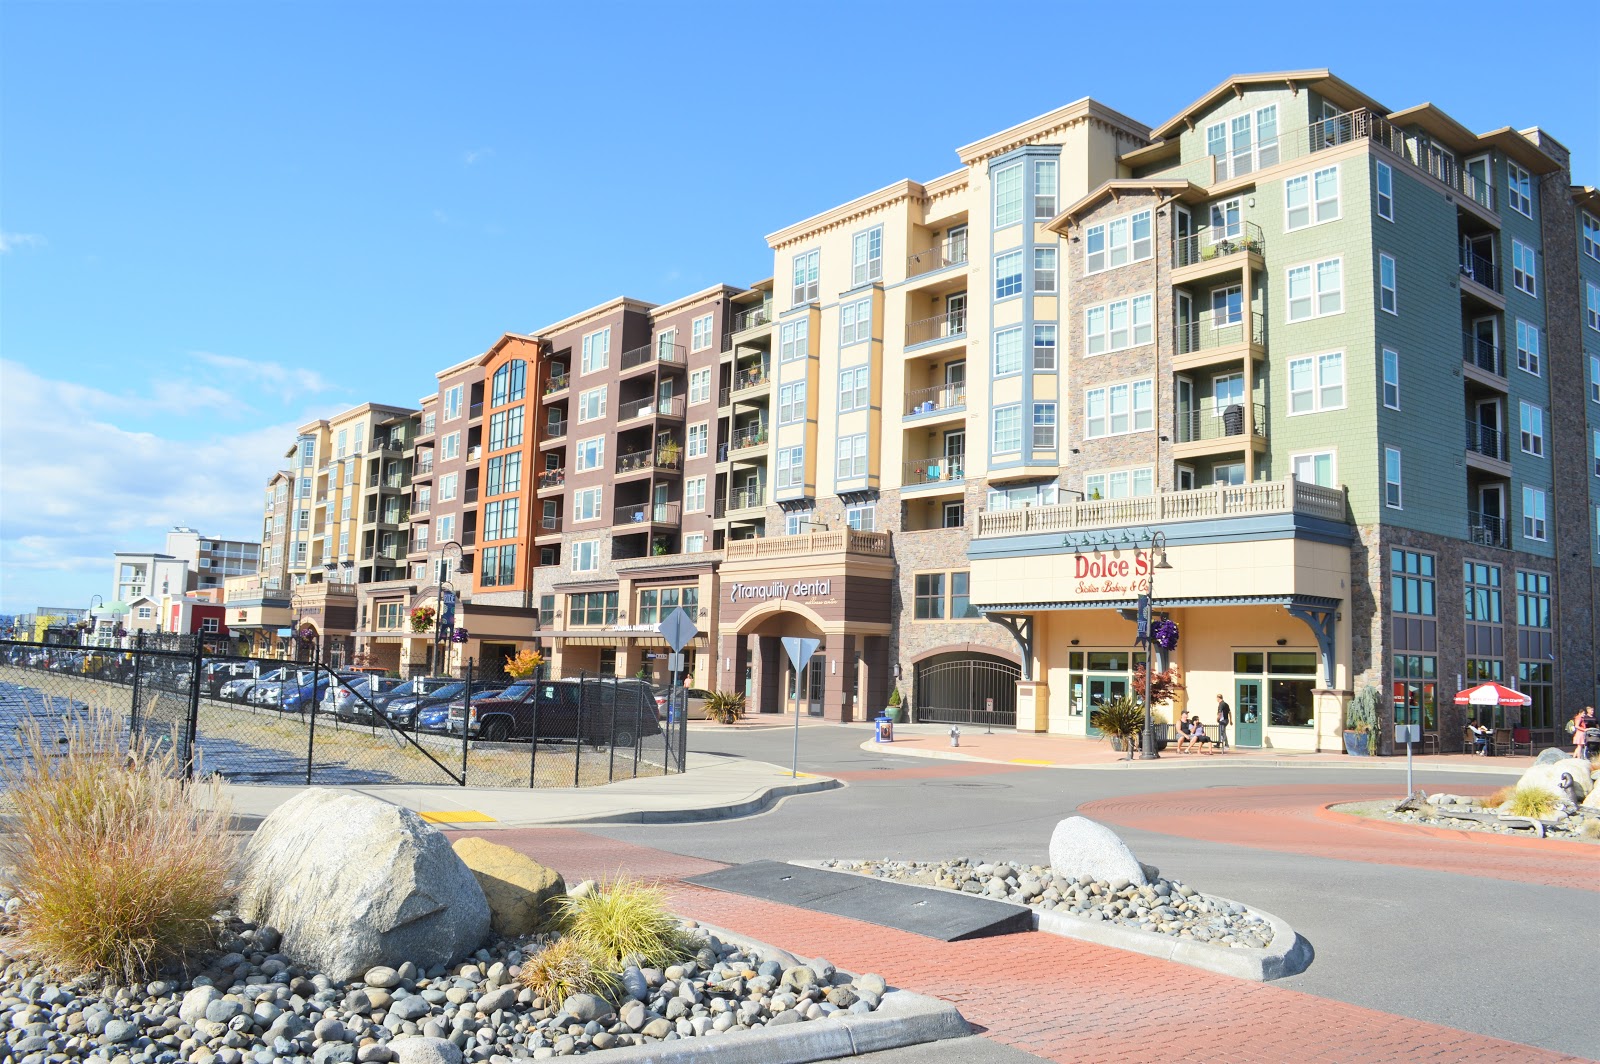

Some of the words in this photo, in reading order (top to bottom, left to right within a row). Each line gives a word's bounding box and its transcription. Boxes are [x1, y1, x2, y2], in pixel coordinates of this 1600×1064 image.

[1074, 553, 1129, 579] Dolce
[737, 582, 791, 600] Tranquility
[793, 579, 831, 596] dental
[1101, 580, 1127, 595] Bakery
[1130, 581, 1136, 592] &
